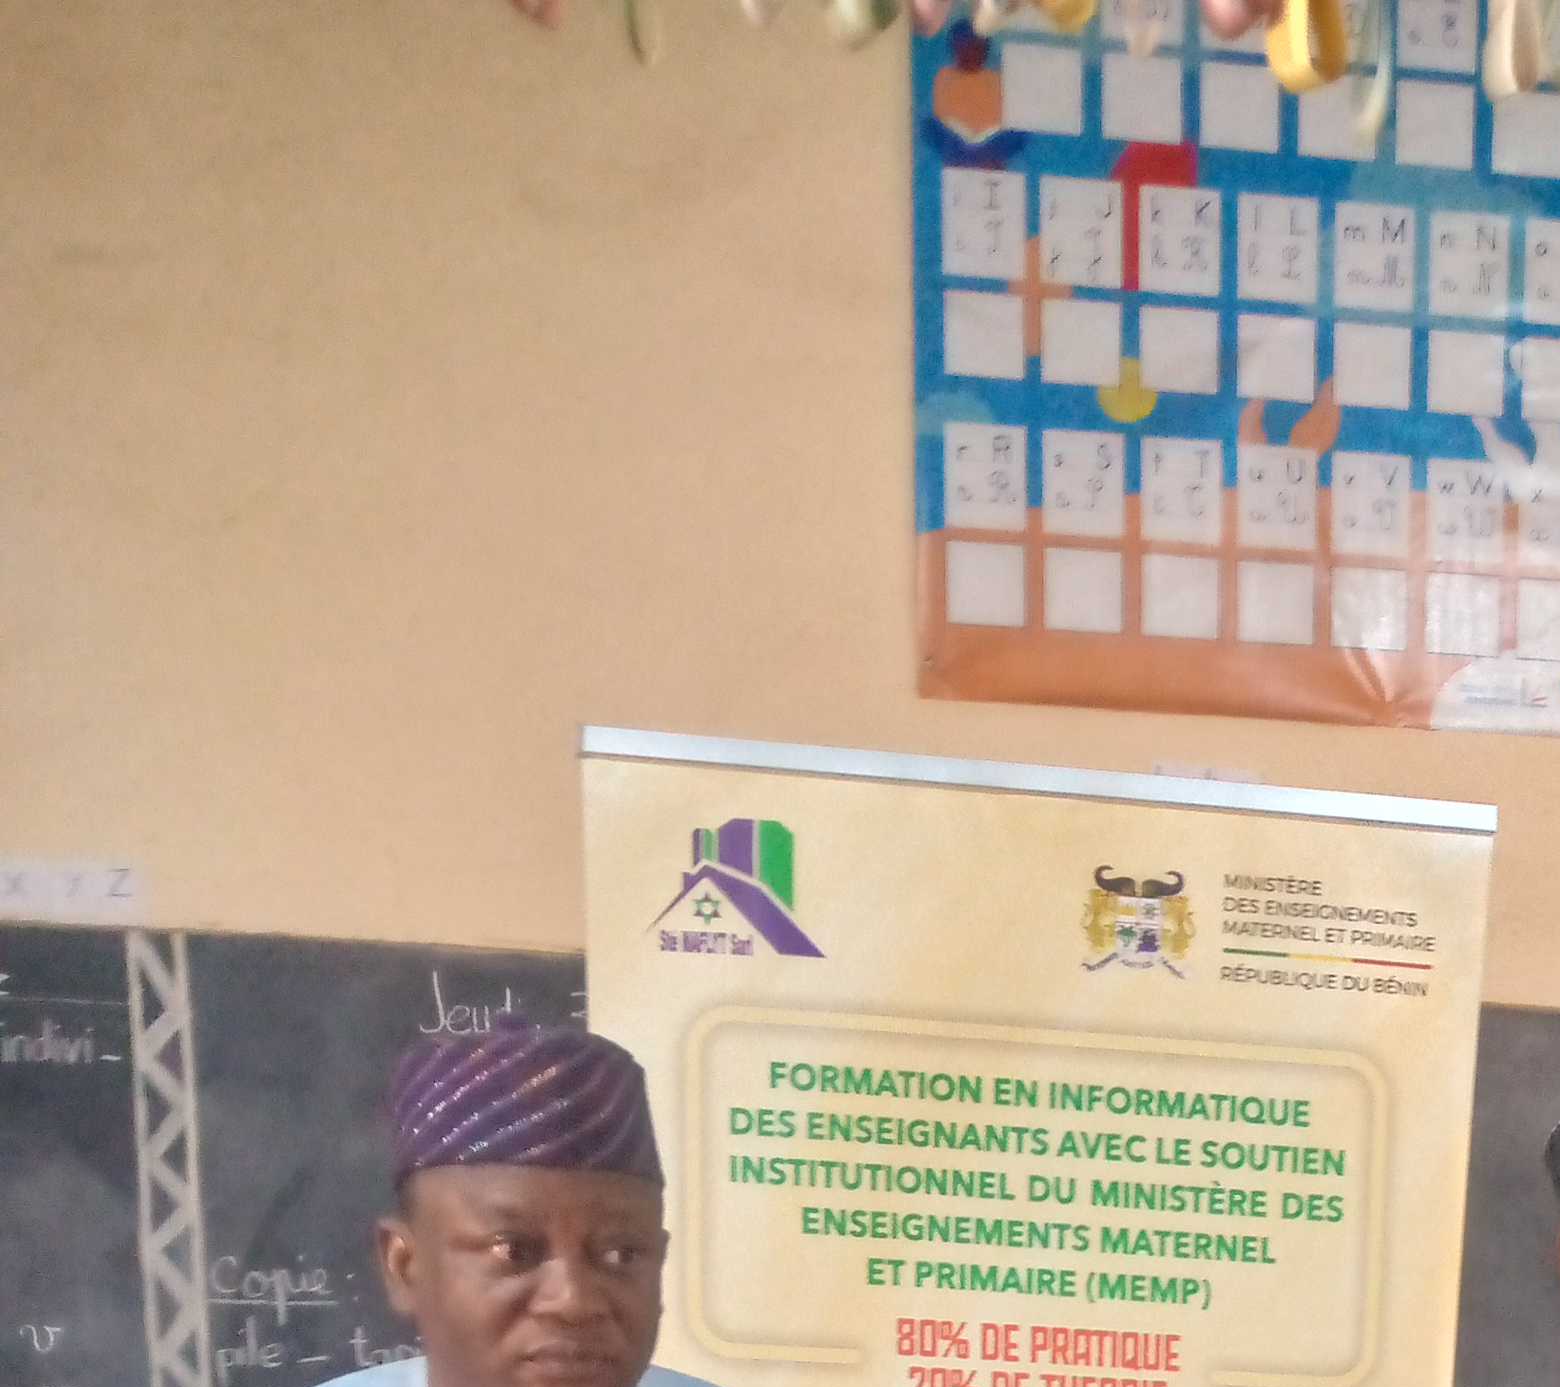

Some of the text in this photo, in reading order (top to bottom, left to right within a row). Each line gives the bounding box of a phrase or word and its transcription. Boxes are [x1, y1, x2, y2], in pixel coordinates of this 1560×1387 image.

[1222, 897, 1418, 927] DES ENSEIGNEMENTS
[1222, 921, 1436, 951] MATERNEL ET PRIMAIRE
[1220, 964, 1337, 990] RÉPUBLIQUE
[1342, 976, 1370, 990] DU
[769, 1062, 1311, 1129] FORMATION EN INFORMATIQUE
[731, 1108, 1346, 1176] DES ENSEIGNANTS AVEC LE SOUTIEN
[729, 1156, 1344, 1223] INSTITUTIONNEL DU MINISTÈRE DES
[801, 1208, 1276, 1265] ENSEIGNEMENTS MATERNEL
[866, 1258, 1212, 1309] ET PRIMAIRE (MEMP)
[896, 1318, 1181, 1373] 80% DE PRATIQUE
